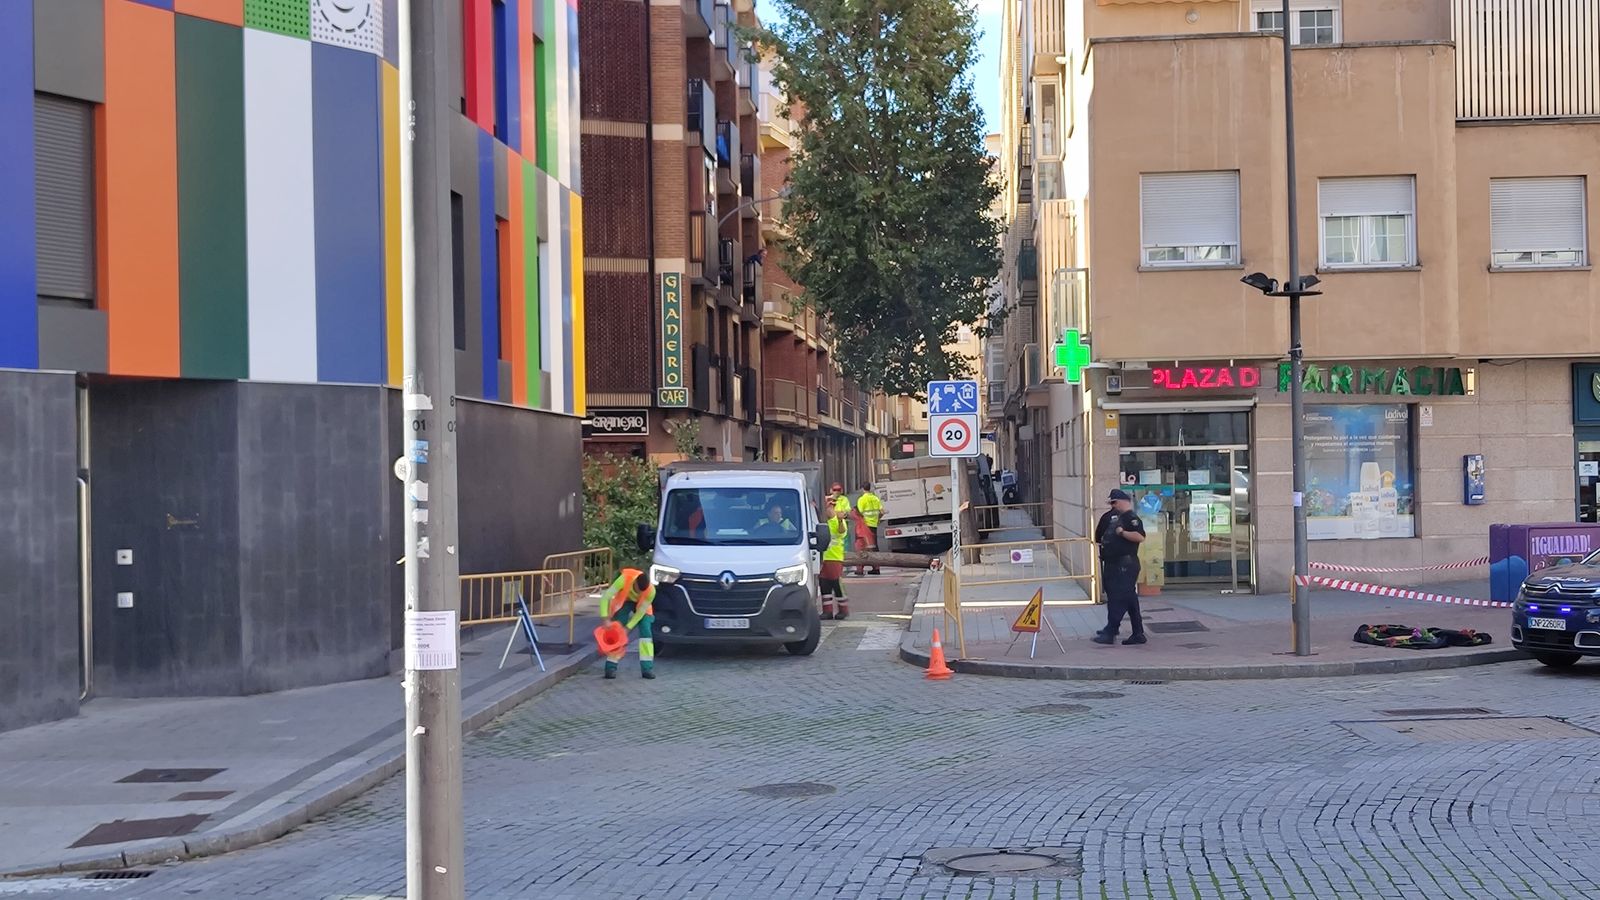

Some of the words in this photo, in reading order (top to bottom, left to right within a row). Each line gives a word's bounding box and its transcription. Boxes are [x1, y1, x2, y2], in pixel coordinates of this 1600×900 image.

[664, 275, 680, 384] GRANERO
[1277, 363, 1466, 396] FARMACIA
[660, 390, 685, 405] CAFE
[592, 416, 643, 431] GRANERO
[945, 429, 963, 441] 20
[1531, 535, 1591, 555] ¡IGUALDAD!
